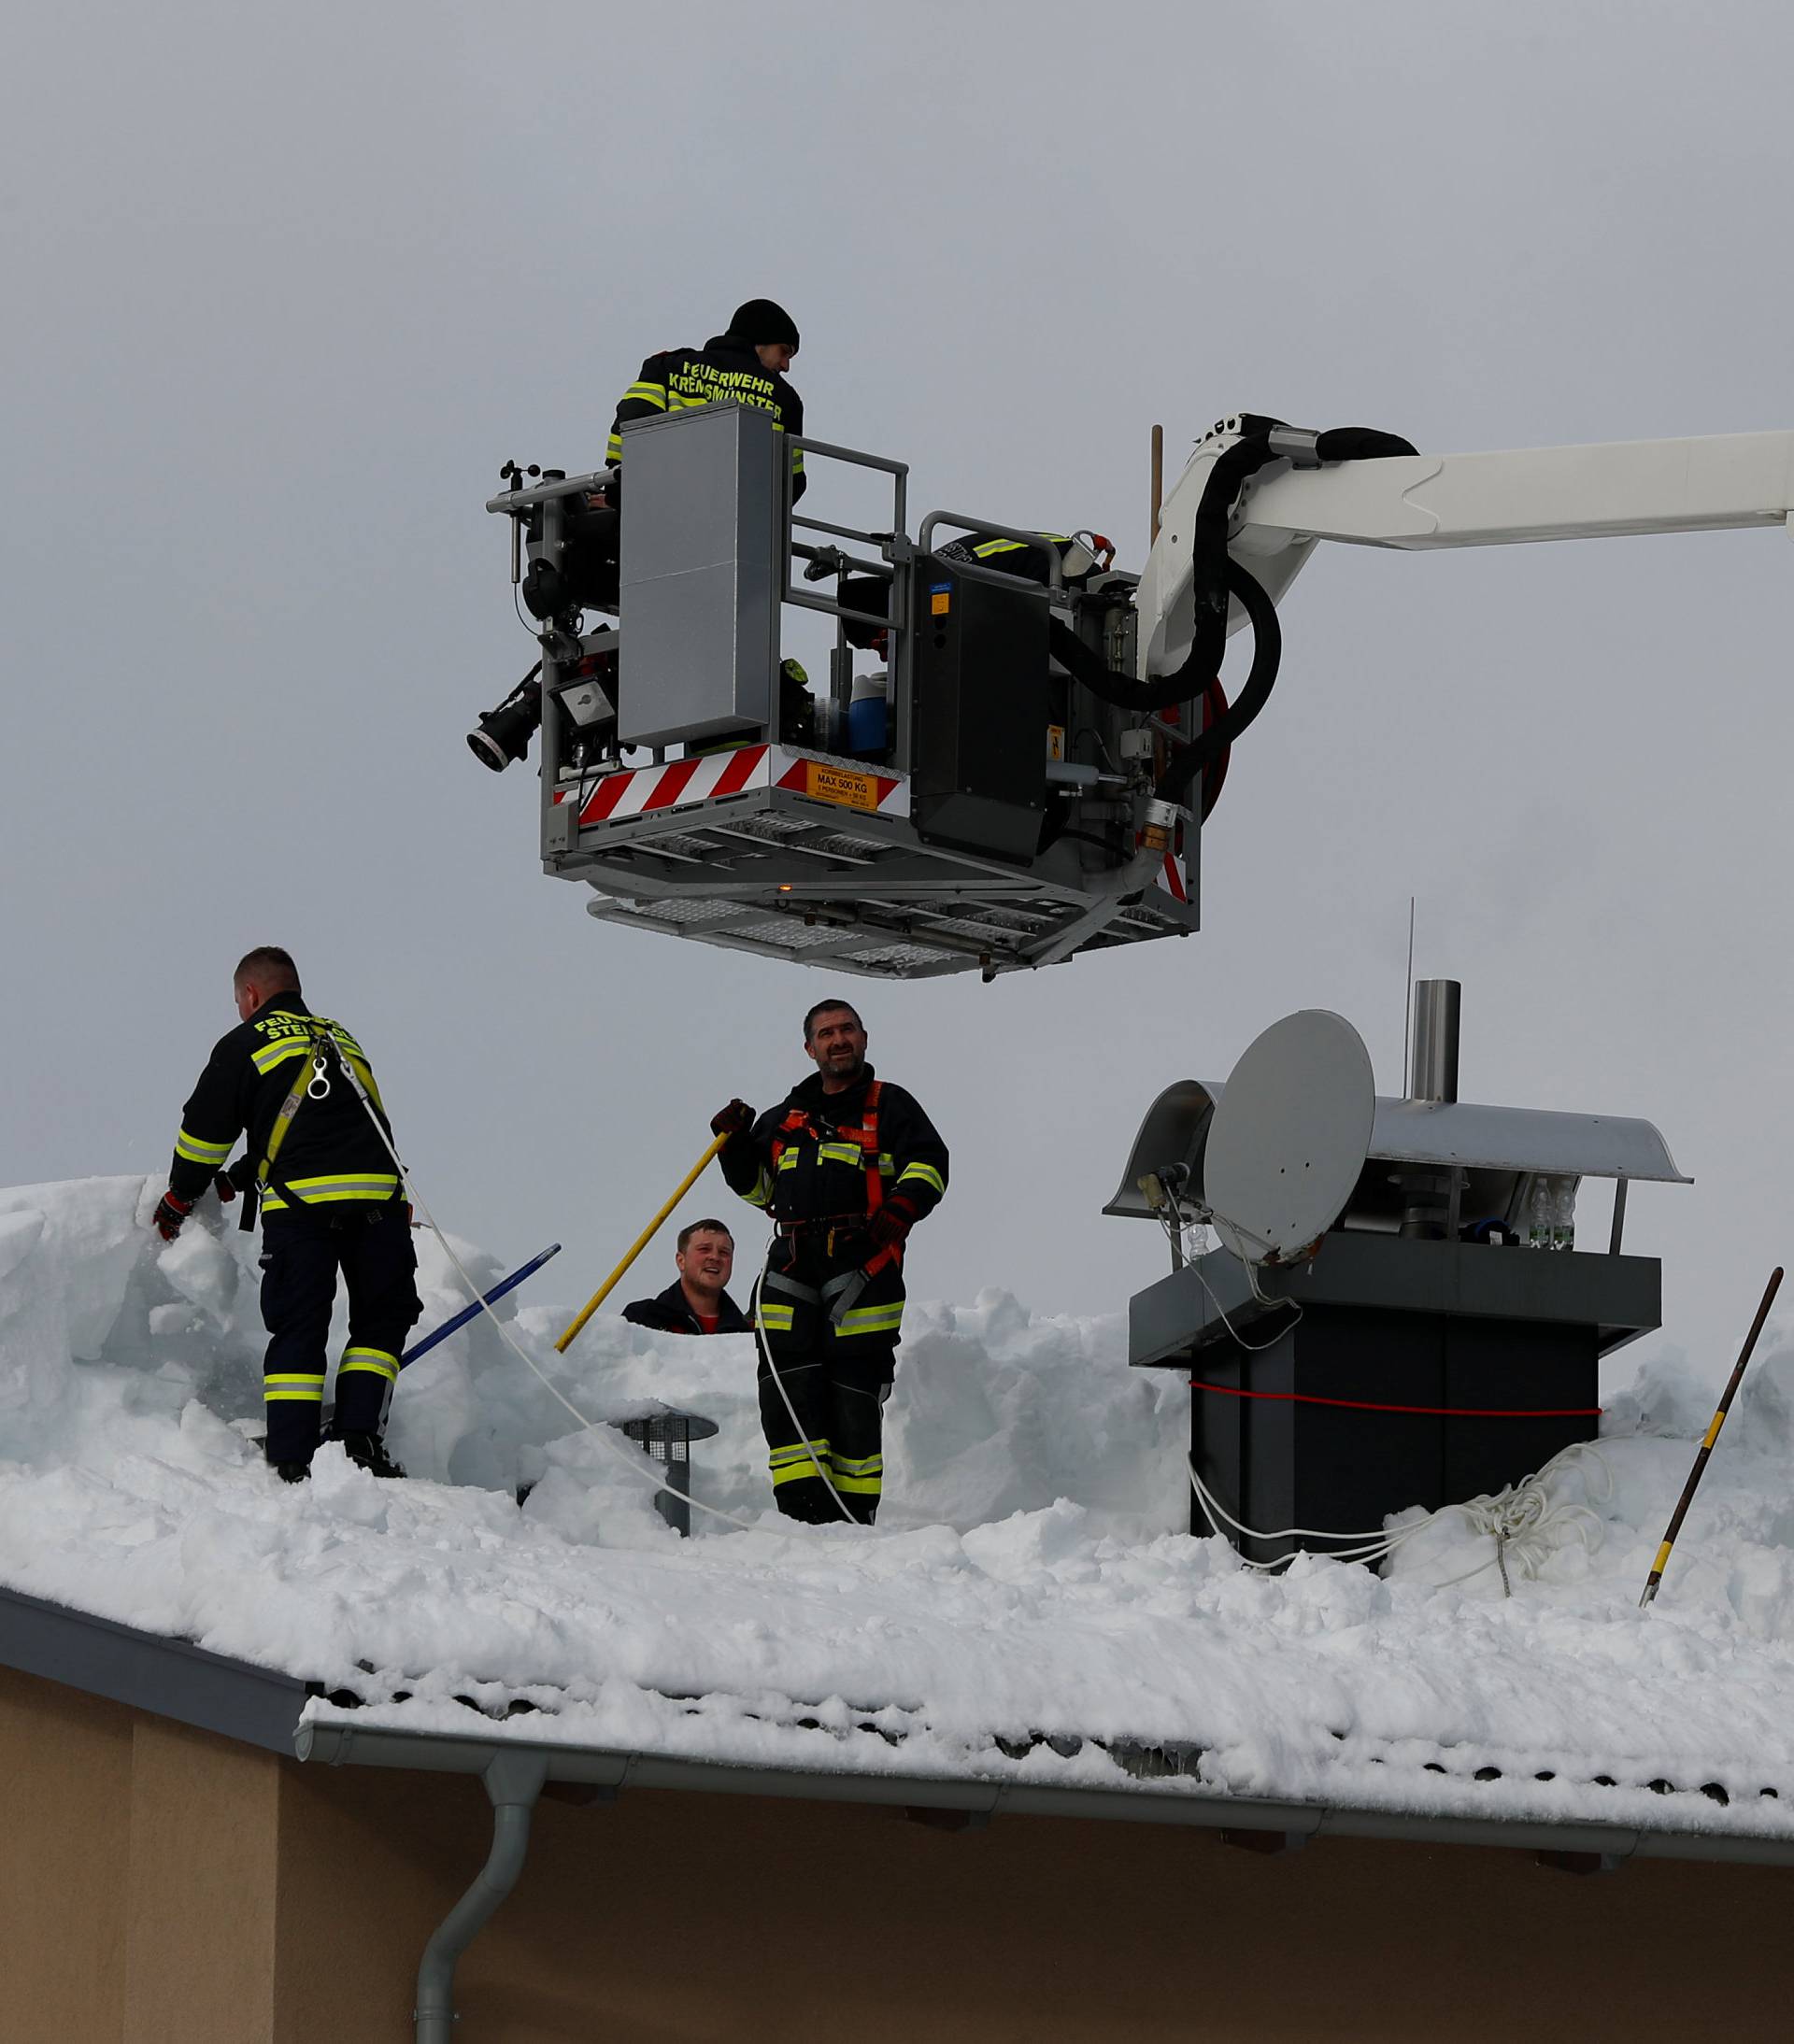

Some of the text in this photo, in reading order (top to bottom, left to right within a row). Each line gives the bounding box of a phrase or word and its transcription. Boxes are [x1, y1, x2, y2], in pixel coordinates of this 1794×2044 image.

[683, 361, 775, 396] FEUERWEHR
[818, 774, 867, 793] MAX 500 KG
